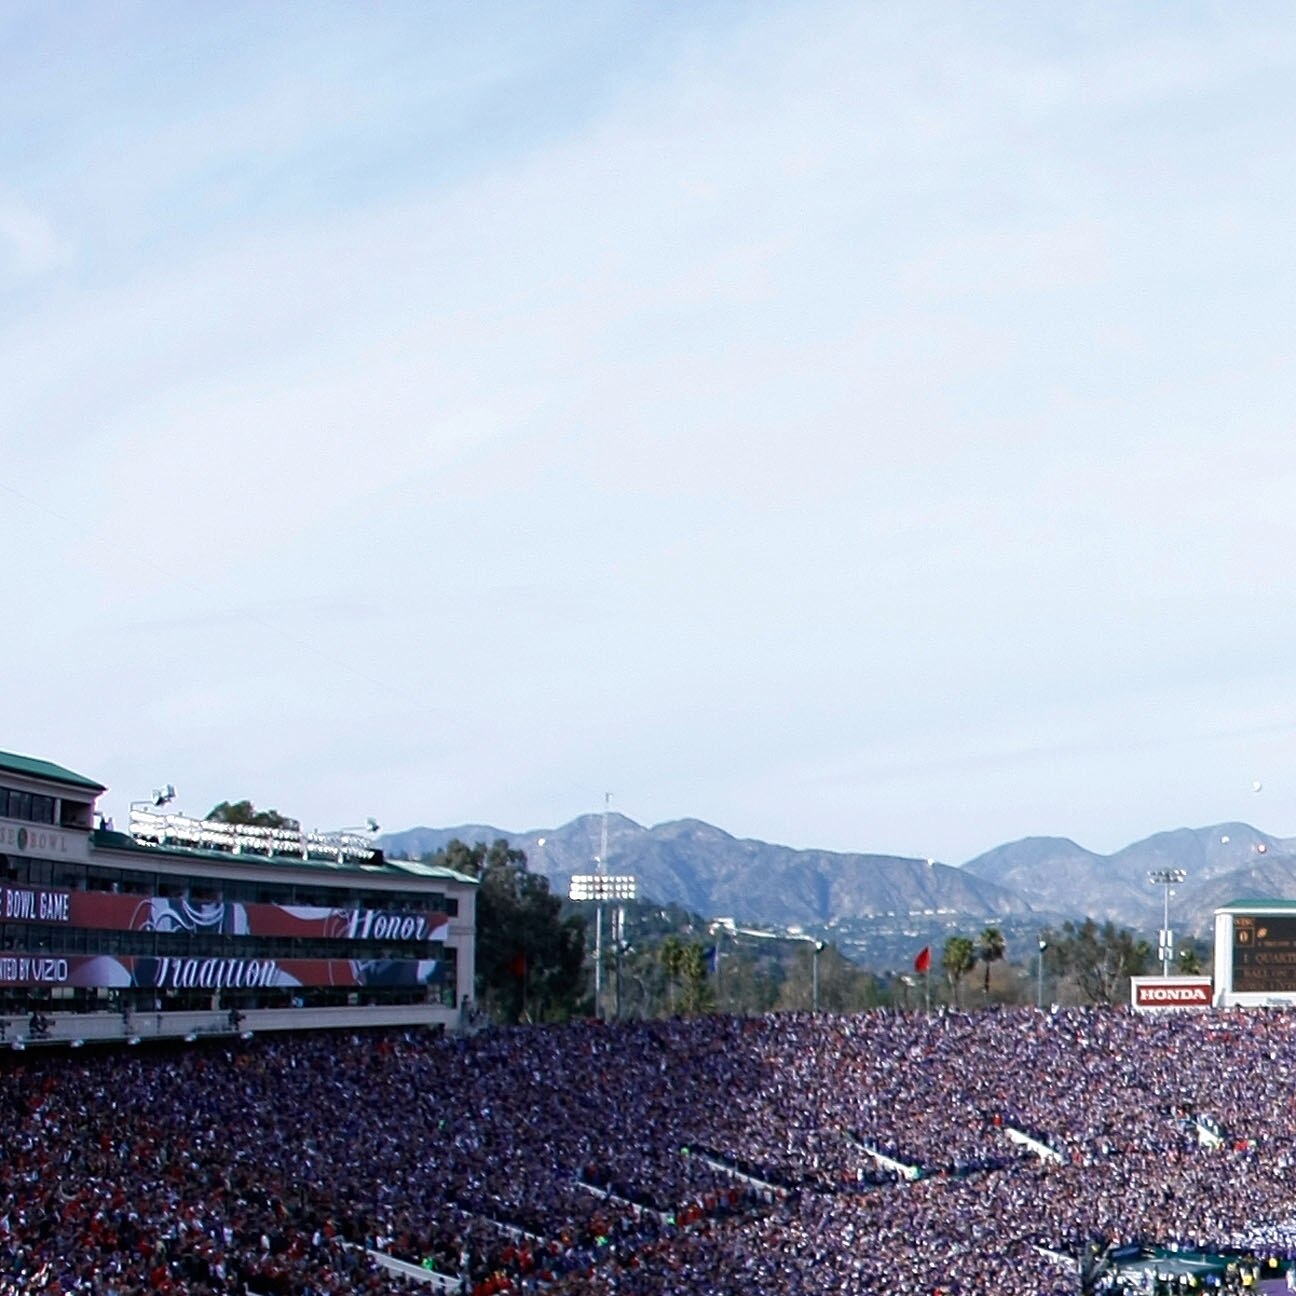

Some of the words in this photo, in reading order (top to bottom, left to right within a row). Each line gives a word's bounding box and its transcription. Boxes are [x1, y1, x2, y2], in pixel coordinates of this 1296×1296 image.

[6, 889, 36, 919] BOWL
[39, 892, 69, 921] GAME
[347, 909, 427, 940] Honor
[1239, 930, 1249, 943] 0
[20, 957, 31, 981] BY
[32, 958, 68, 982] VIZIO
[1140, 989, 1207, 1001] HONDA
